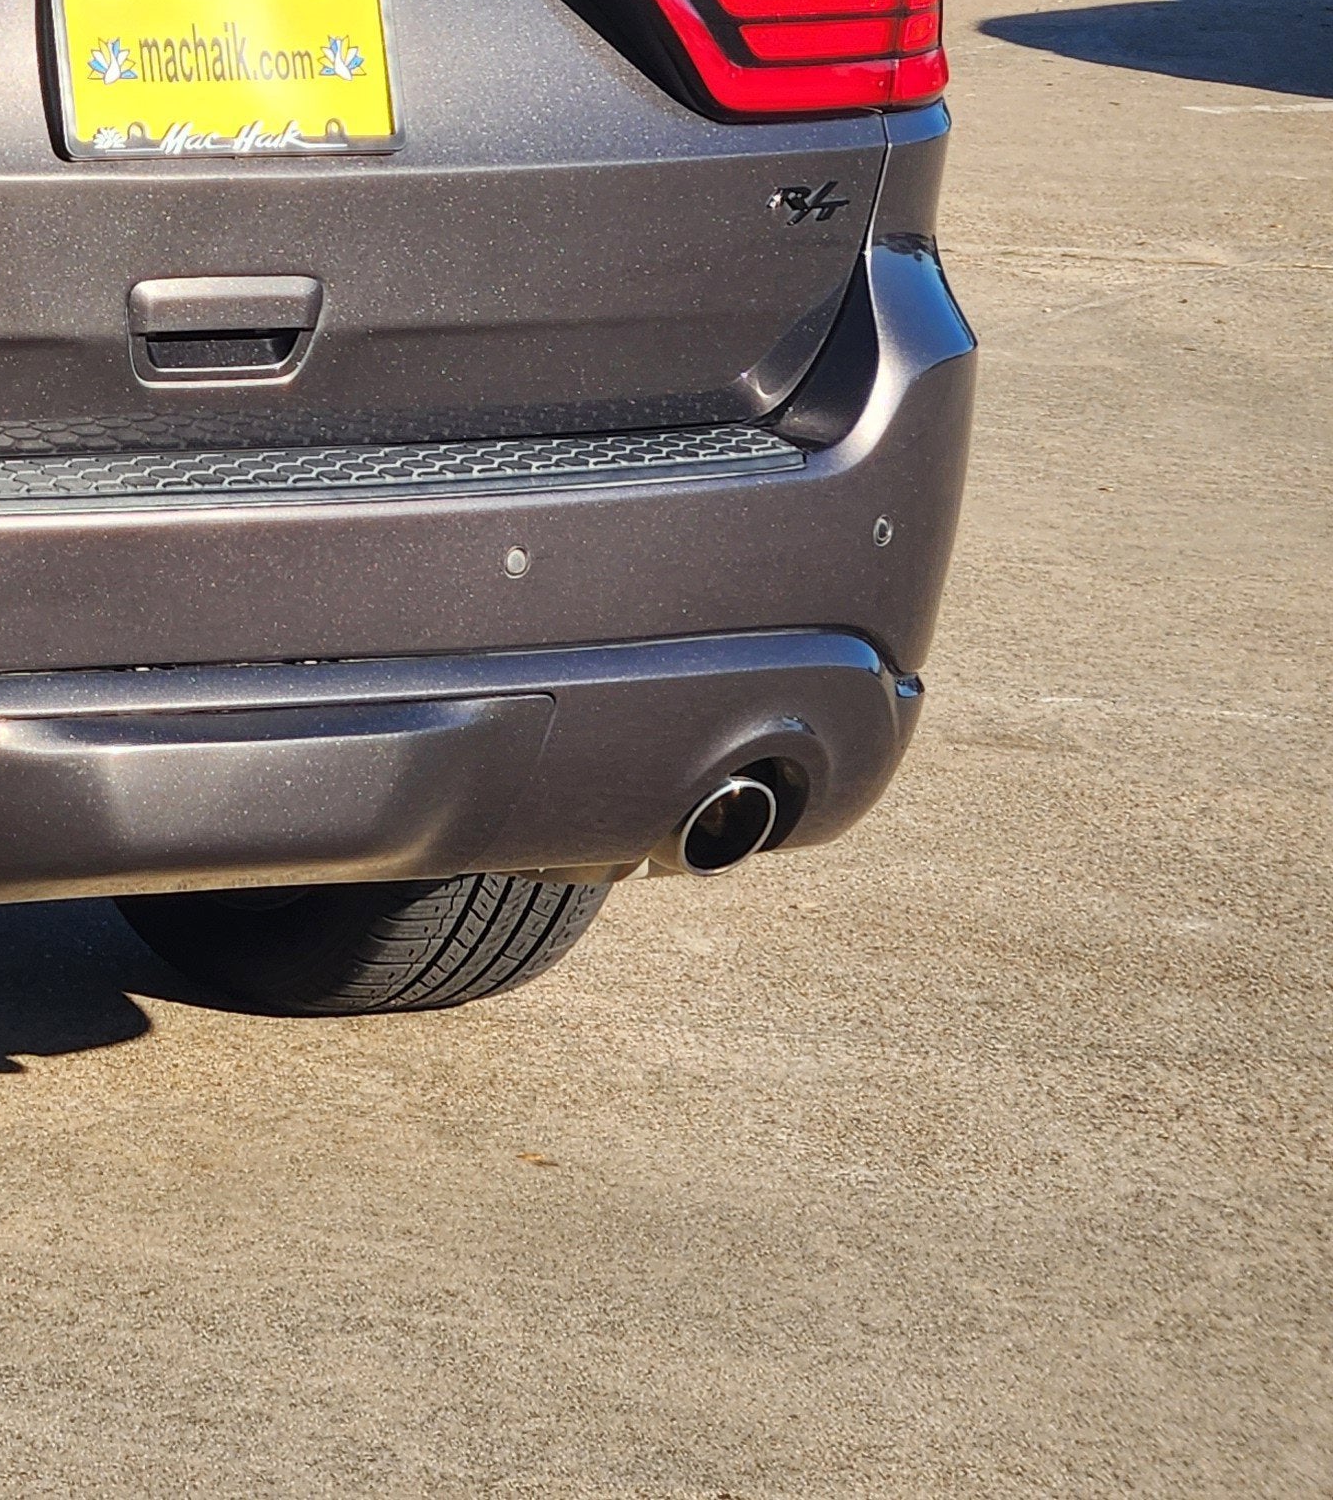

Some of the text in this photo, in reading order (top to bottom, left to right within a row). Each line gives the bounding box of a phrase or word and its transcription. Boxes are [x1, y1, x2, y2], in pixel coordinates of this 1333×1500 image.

[138, 22, 315, 83] machaik.com
[159, 120, 347, 155] Mac Haik
